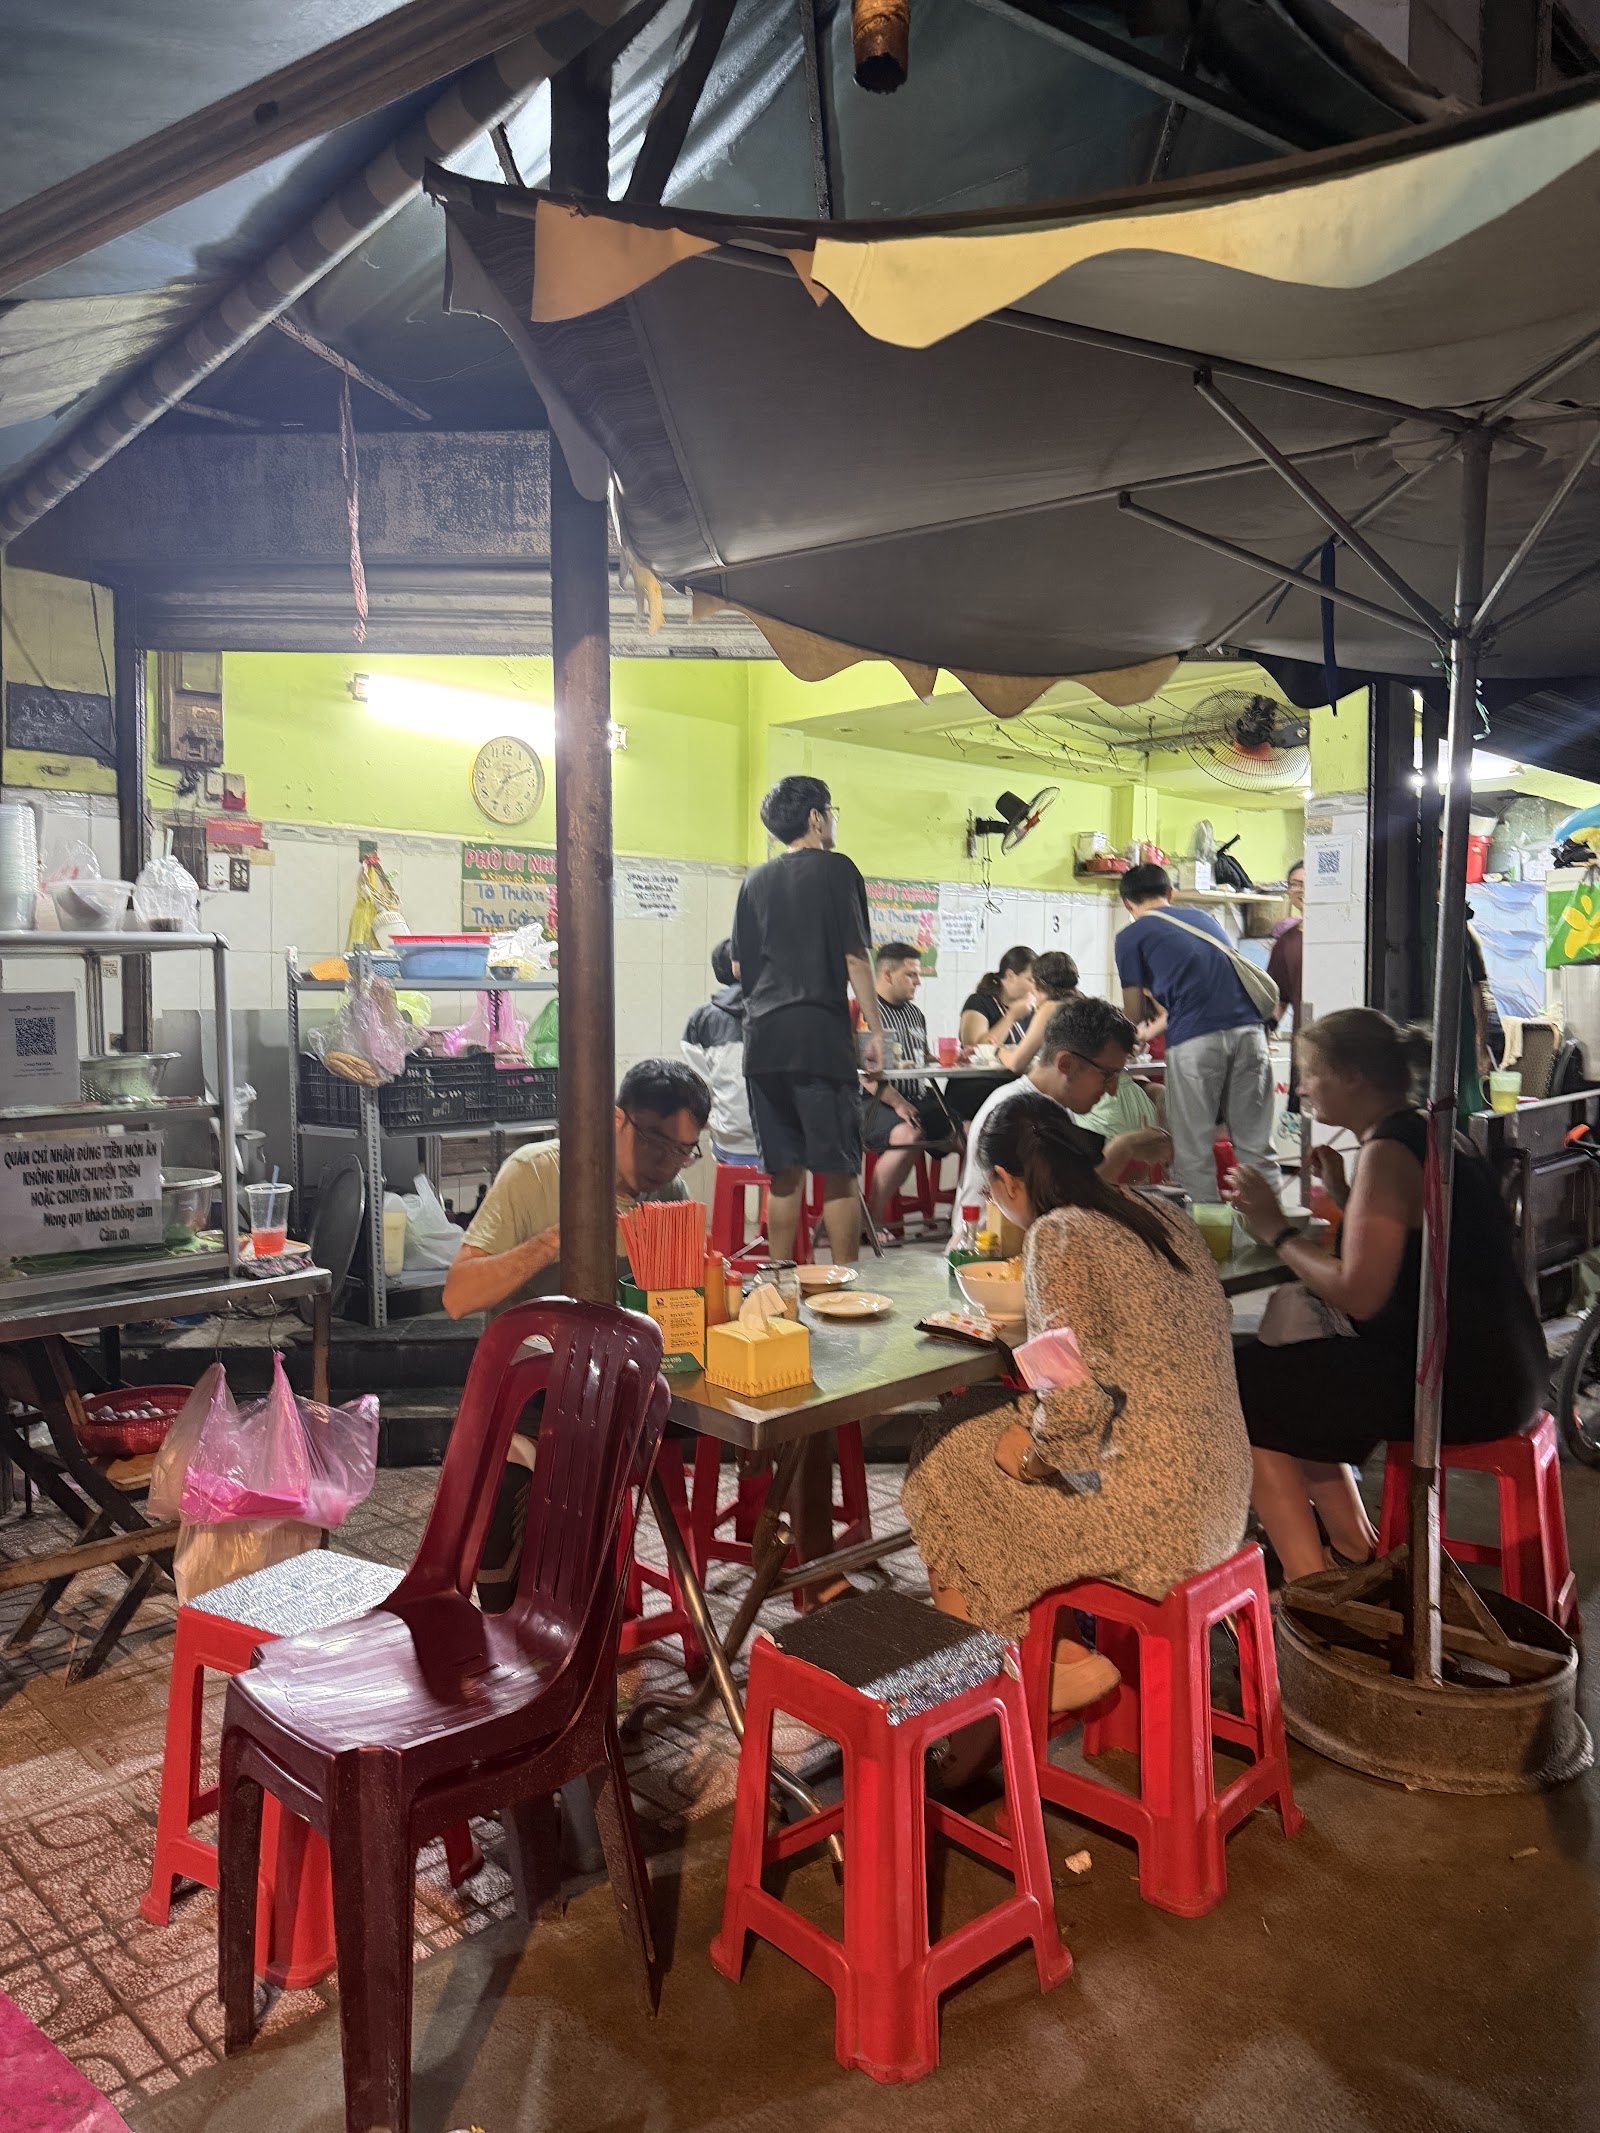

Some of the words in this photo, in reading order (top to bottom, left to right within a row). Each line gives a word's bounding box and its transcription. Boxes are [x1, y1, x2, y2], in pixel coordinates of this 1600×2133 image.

[1052, 914, 1060, 934] 3
[4, 1145, 30, 1169] QUÁN
[50, 1143, 75, 1166] NHẬN
[23, 1166, 54, 1186] KHÔNG
[56, 1164, 81, 1185] NHẬN
[85, 1206, 110, 1222] khách
[112, 1204, 134, 1221] thông
